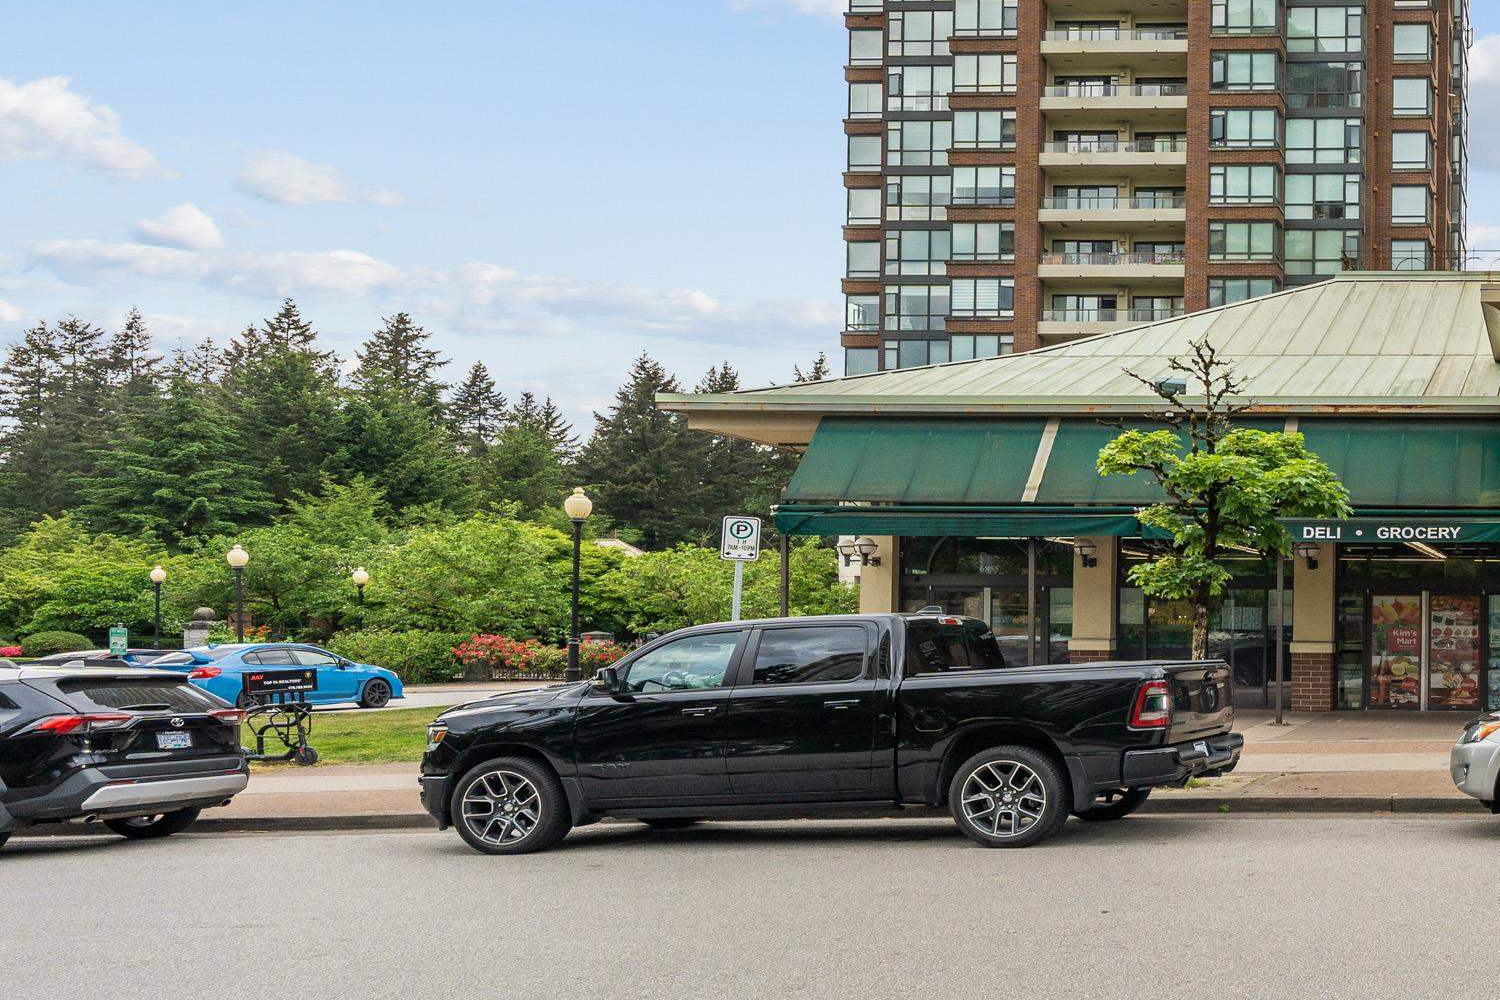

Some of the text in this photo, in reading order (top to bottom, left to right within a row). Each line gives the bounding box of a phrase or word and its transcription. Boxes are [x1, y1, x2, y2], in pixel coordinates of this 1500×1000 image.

[736, 524, 748, 535] P
[1303, 527, 1341, 539] DELI
[1376, 526, 1461, 539] GROCERY
[1392, 629, 1417, 637] Kim's
